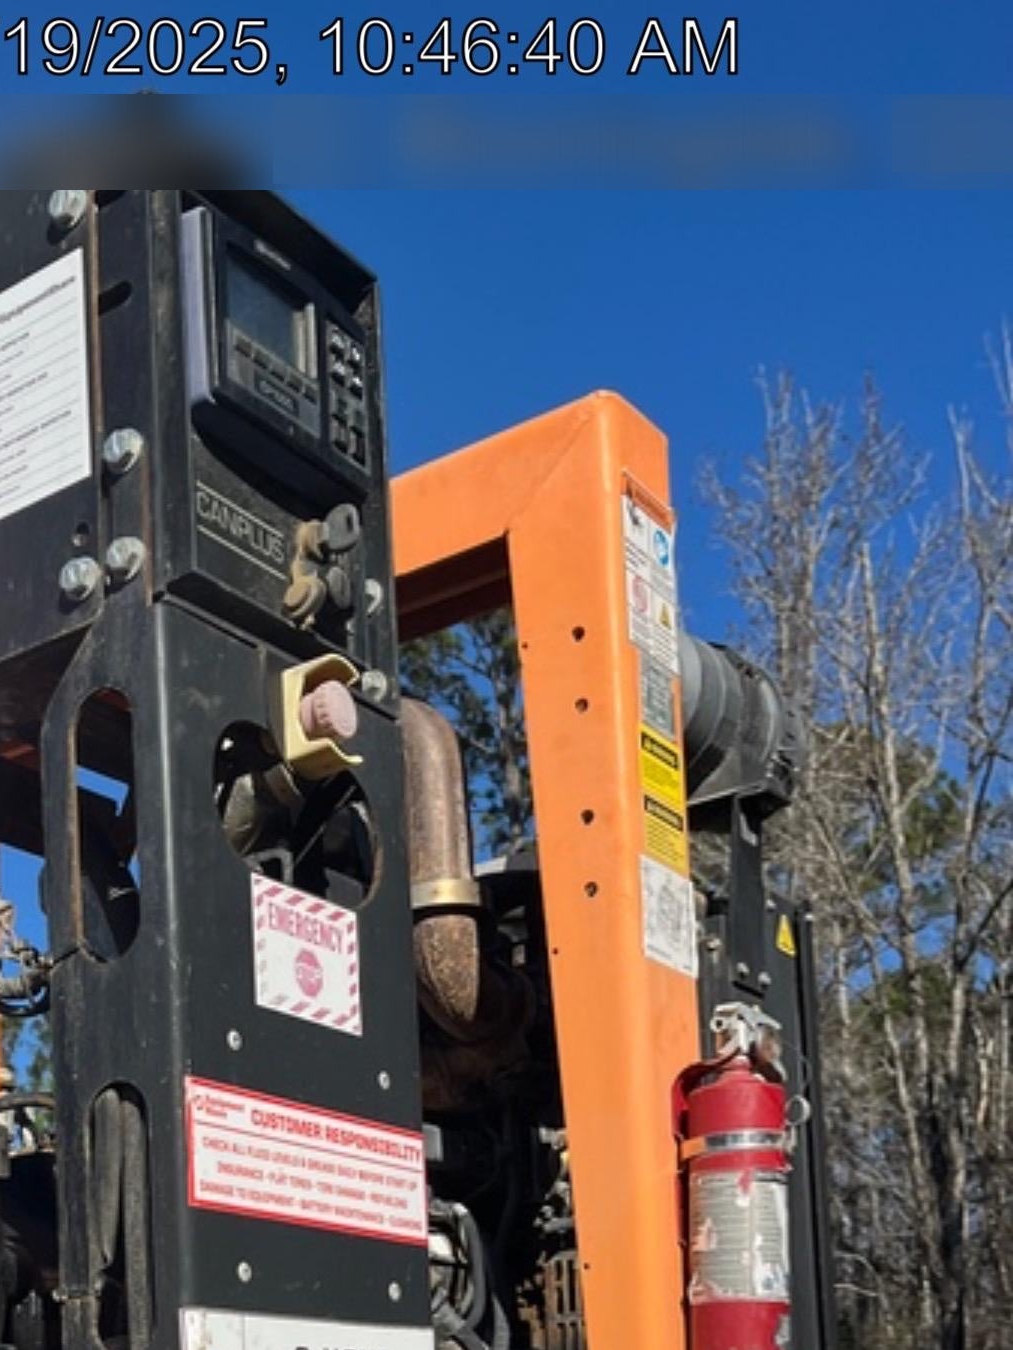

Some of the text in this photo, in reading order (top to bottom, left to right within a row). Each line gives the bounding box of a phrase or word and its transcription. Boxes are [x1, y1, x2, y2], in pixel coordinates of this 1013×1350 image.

[195, 491, 285, 565] CANPLUS
[267, 901, 345, 955] EMERGENCY
[202, 1136, 228, 1152] CHECK
[250, 1108, 421, 1164] CUSTOMER RESPONSIBILITY
